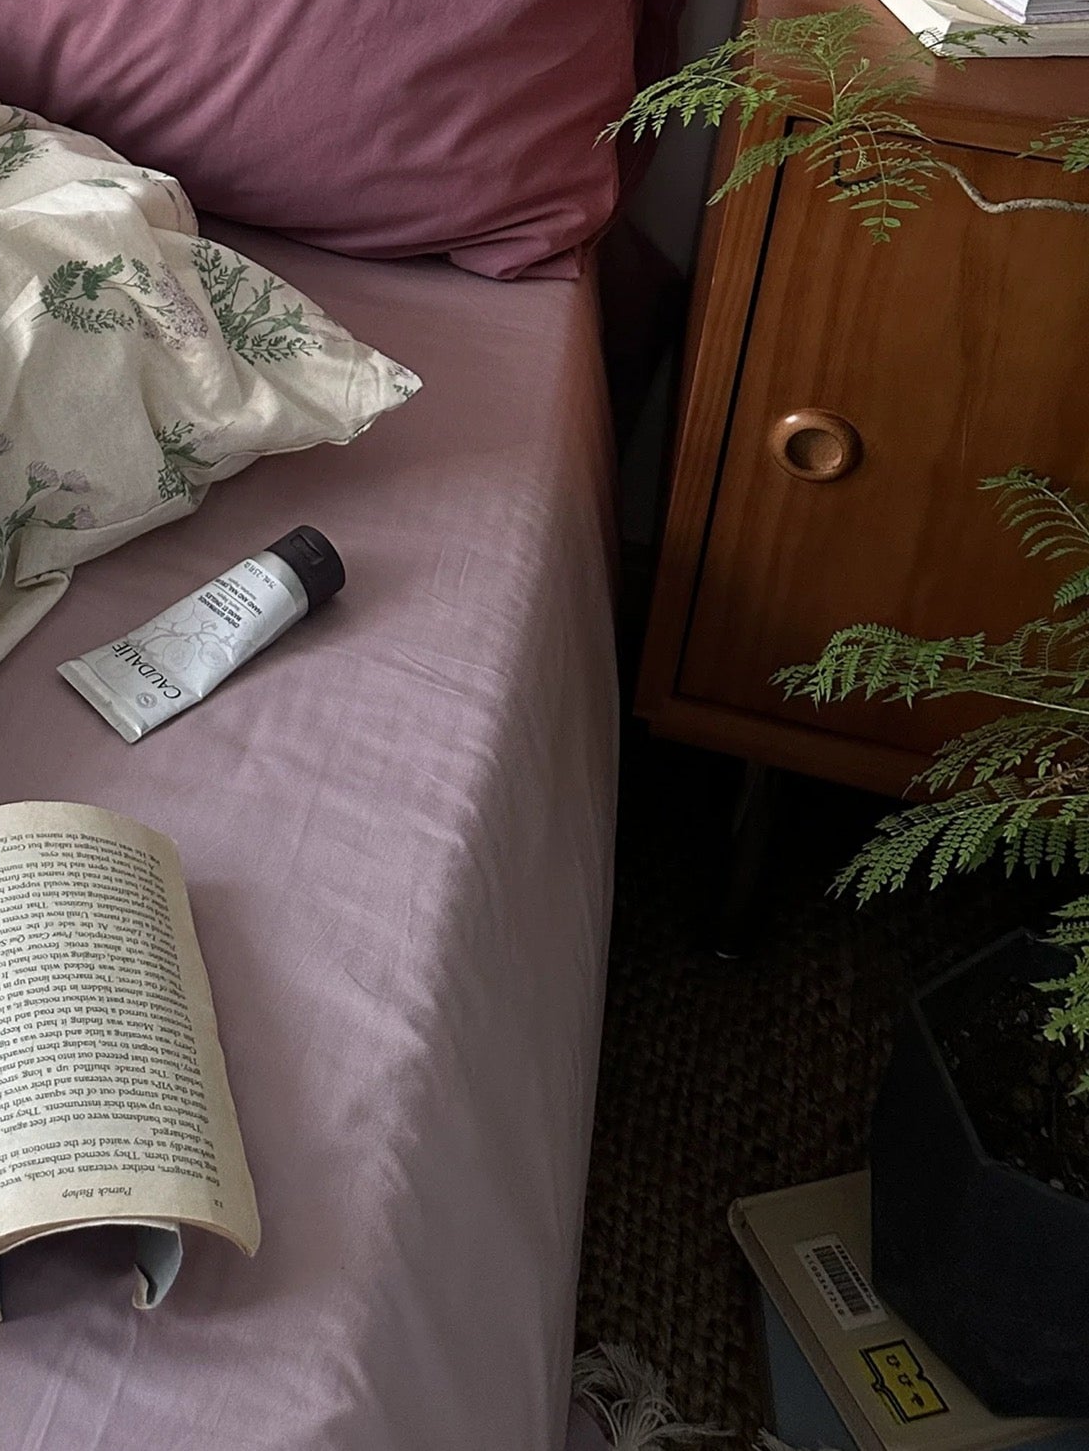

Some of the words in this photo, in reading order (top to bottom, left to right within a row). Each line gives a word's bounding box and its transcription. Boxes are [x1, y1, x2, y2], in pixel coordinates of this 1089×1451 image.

[228, 584, 239, 596] NAIL
[238, 592, 248, 603] AND
[248, 601, 262, 616] HAND
[57, 1166, 74, 1176] nor
[78, 1164, 118, 1174] veterans
[122, 1164, 155, 1174] neither
[0, 1176, 22, 1188] were
[62, 1188, 94, 1199] Bishop
[98, 1186, 132, 1196] Patrick
